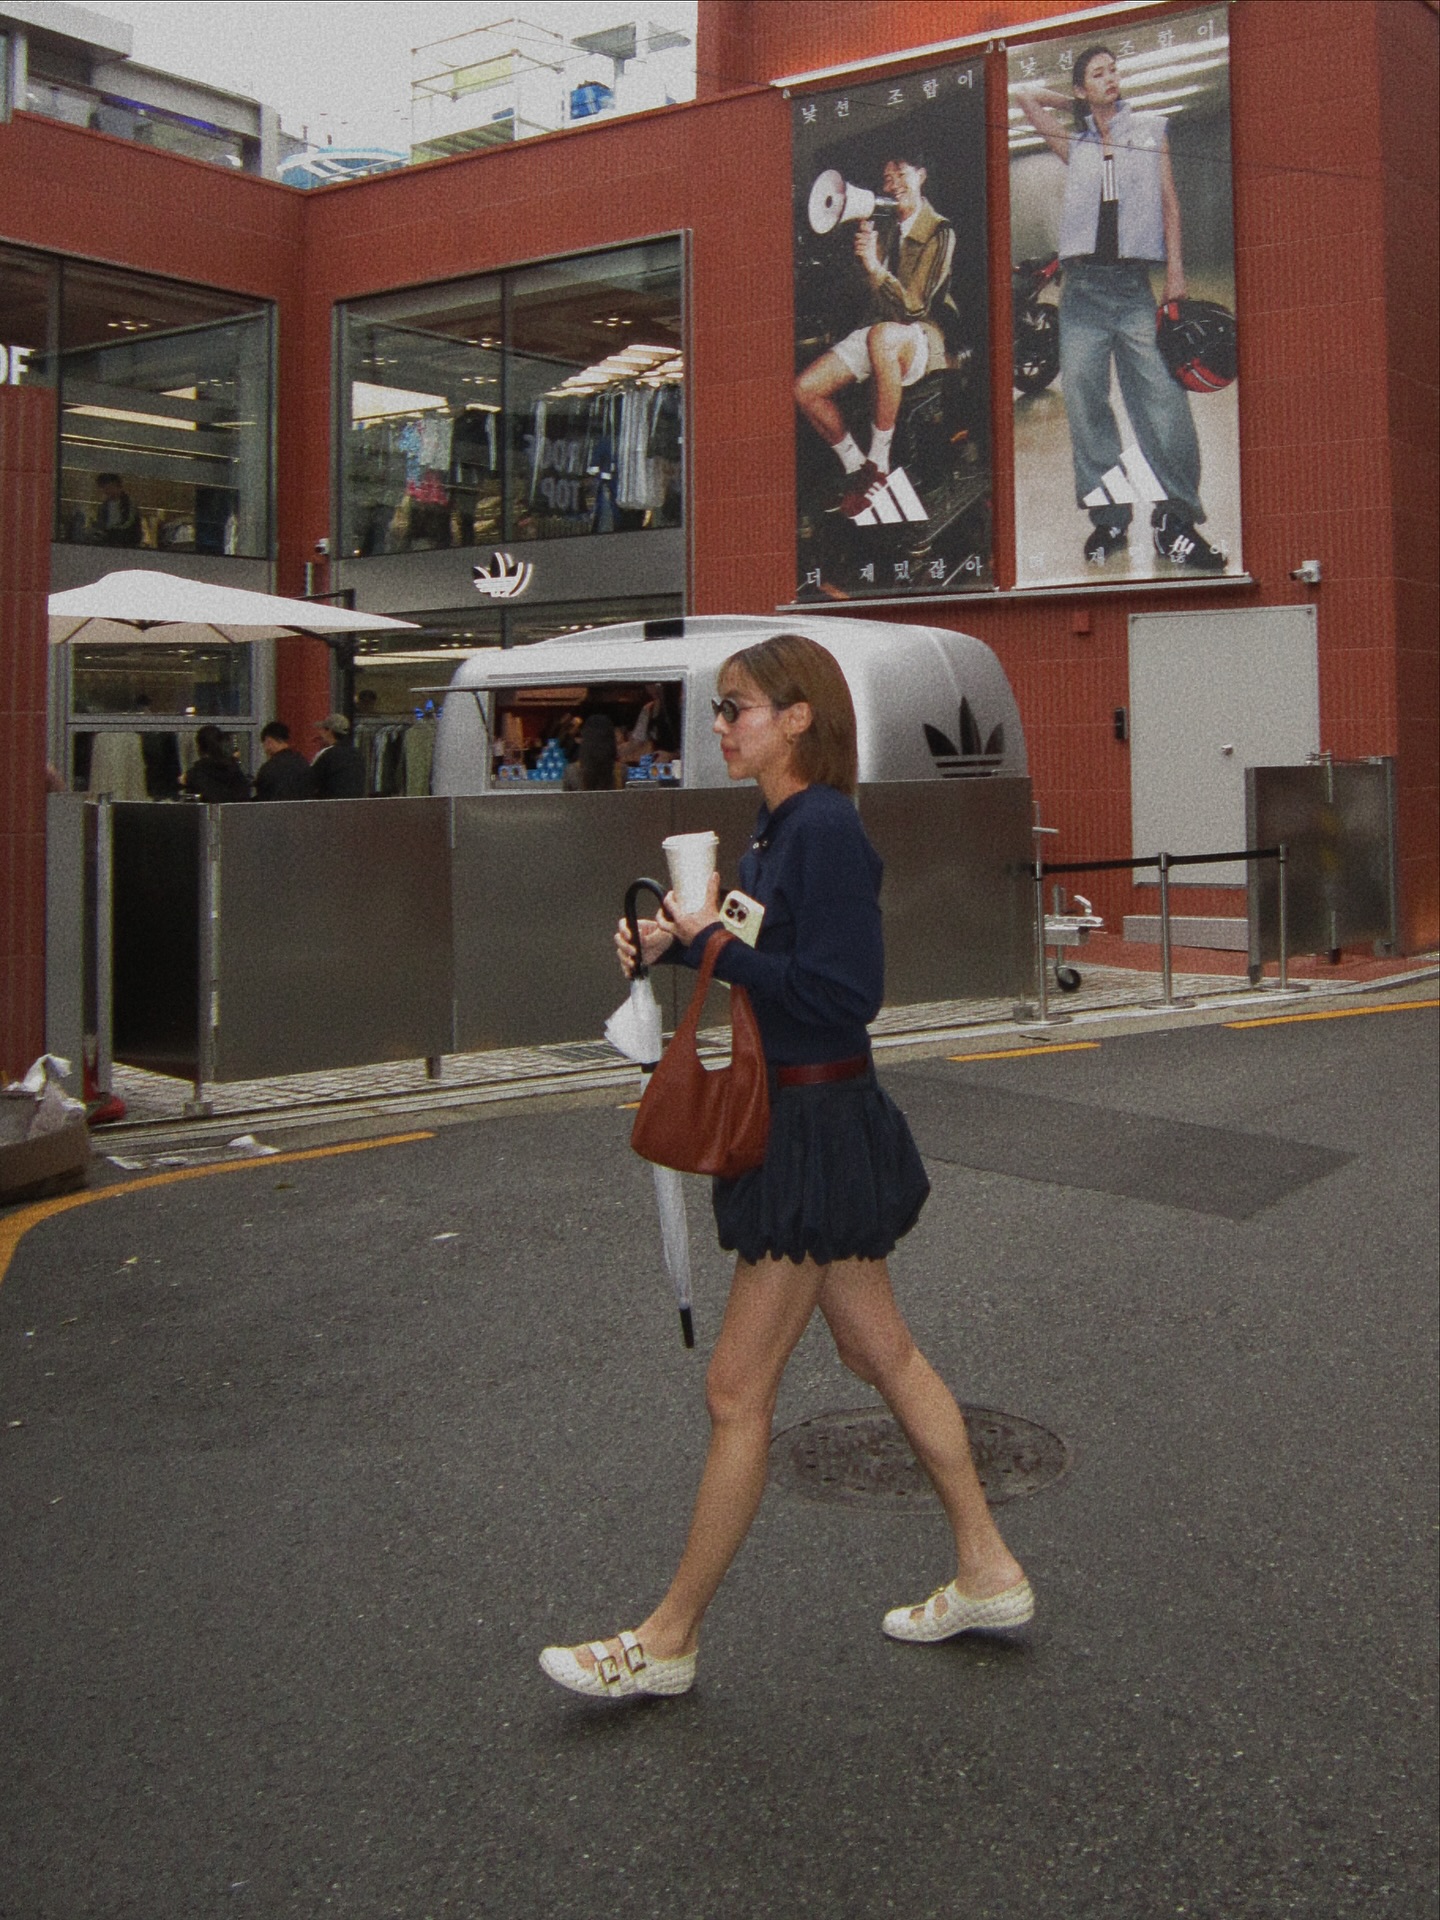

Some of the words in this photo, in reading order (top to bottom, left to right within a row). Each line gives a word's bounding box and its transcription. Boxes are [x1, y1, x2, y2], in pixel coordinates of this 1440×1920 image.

[802, 98, 850, 125] 낯선
[887, 69, 973, 106] 조합이
[806, 568, 821, 587] 더
